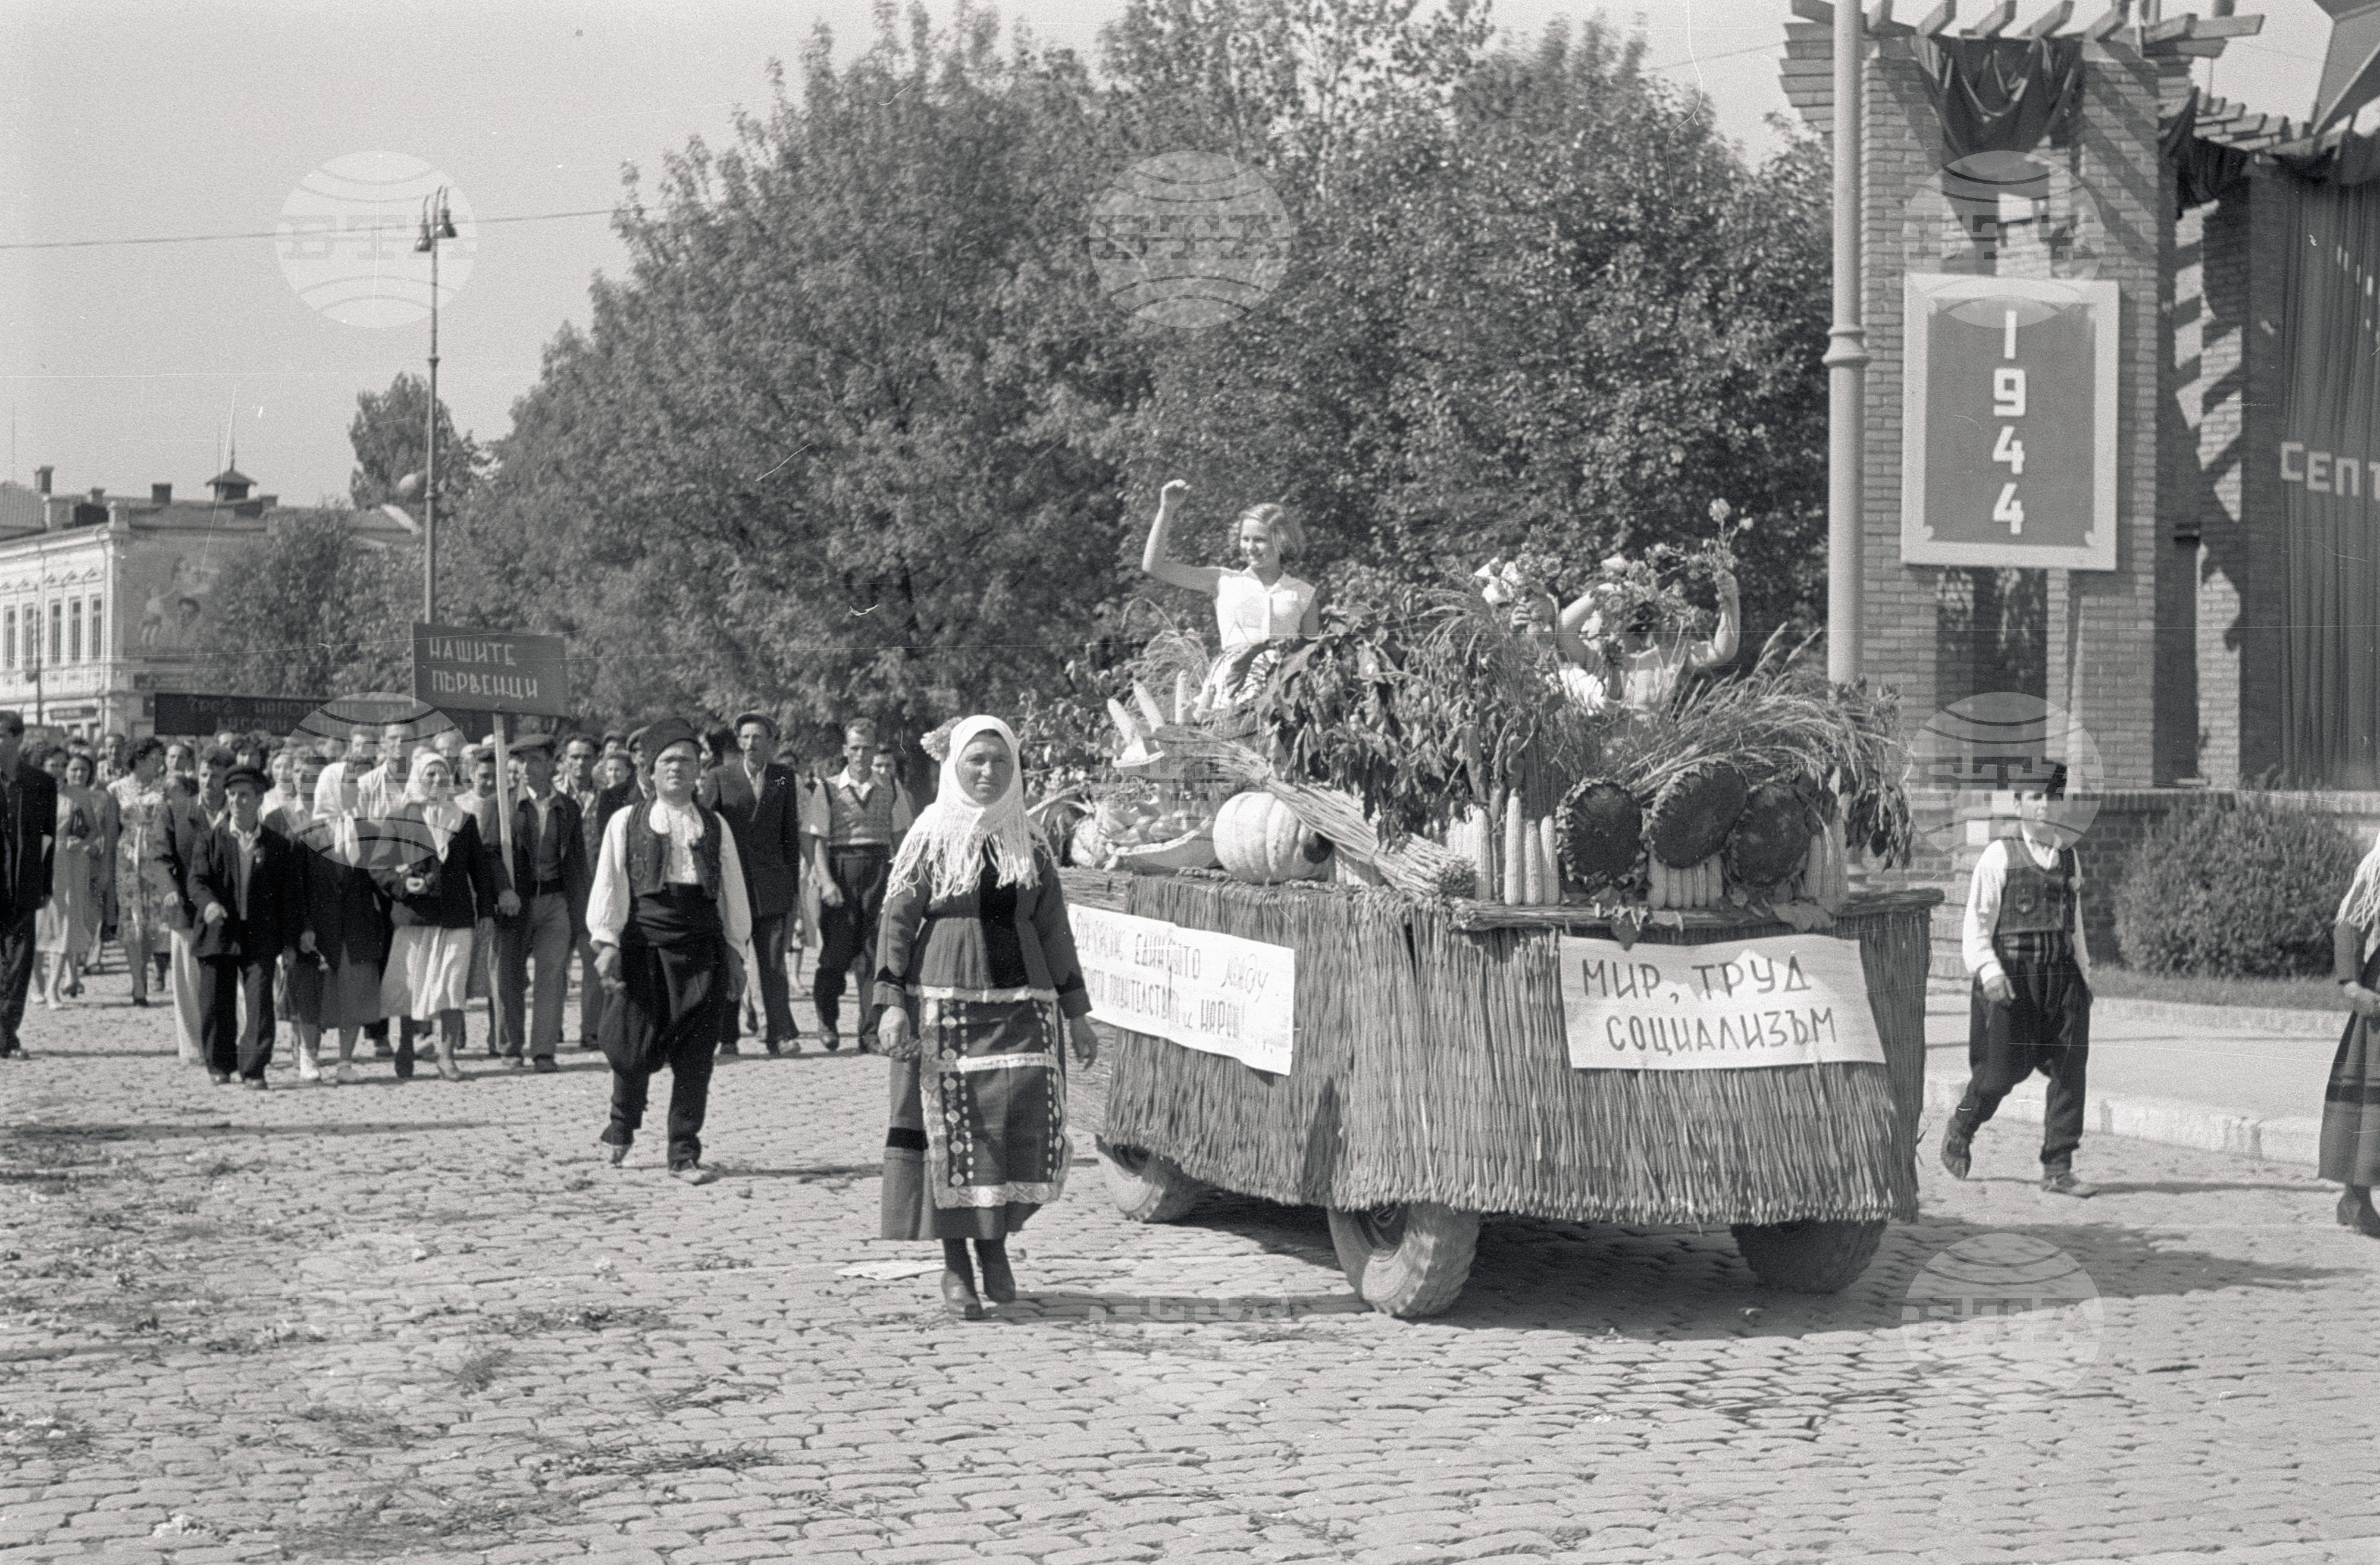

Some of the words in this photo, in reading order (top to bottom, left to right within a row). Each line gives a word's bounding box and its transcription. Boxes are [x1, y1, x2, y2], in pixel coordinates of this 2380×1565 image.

[1992, 310, 2027, 536] 1944
[428, 637, 517, 667] НАШИТЕ
[431, 669, 538, 700] ПЪРВЕНЦИ
[1582, 959, 1680, 1004] МИР,
[1692, 955, 1811, 1001] ТРУД
[1605, 1007, 1837, 1056] СОЦИАЛИЗЪМ
